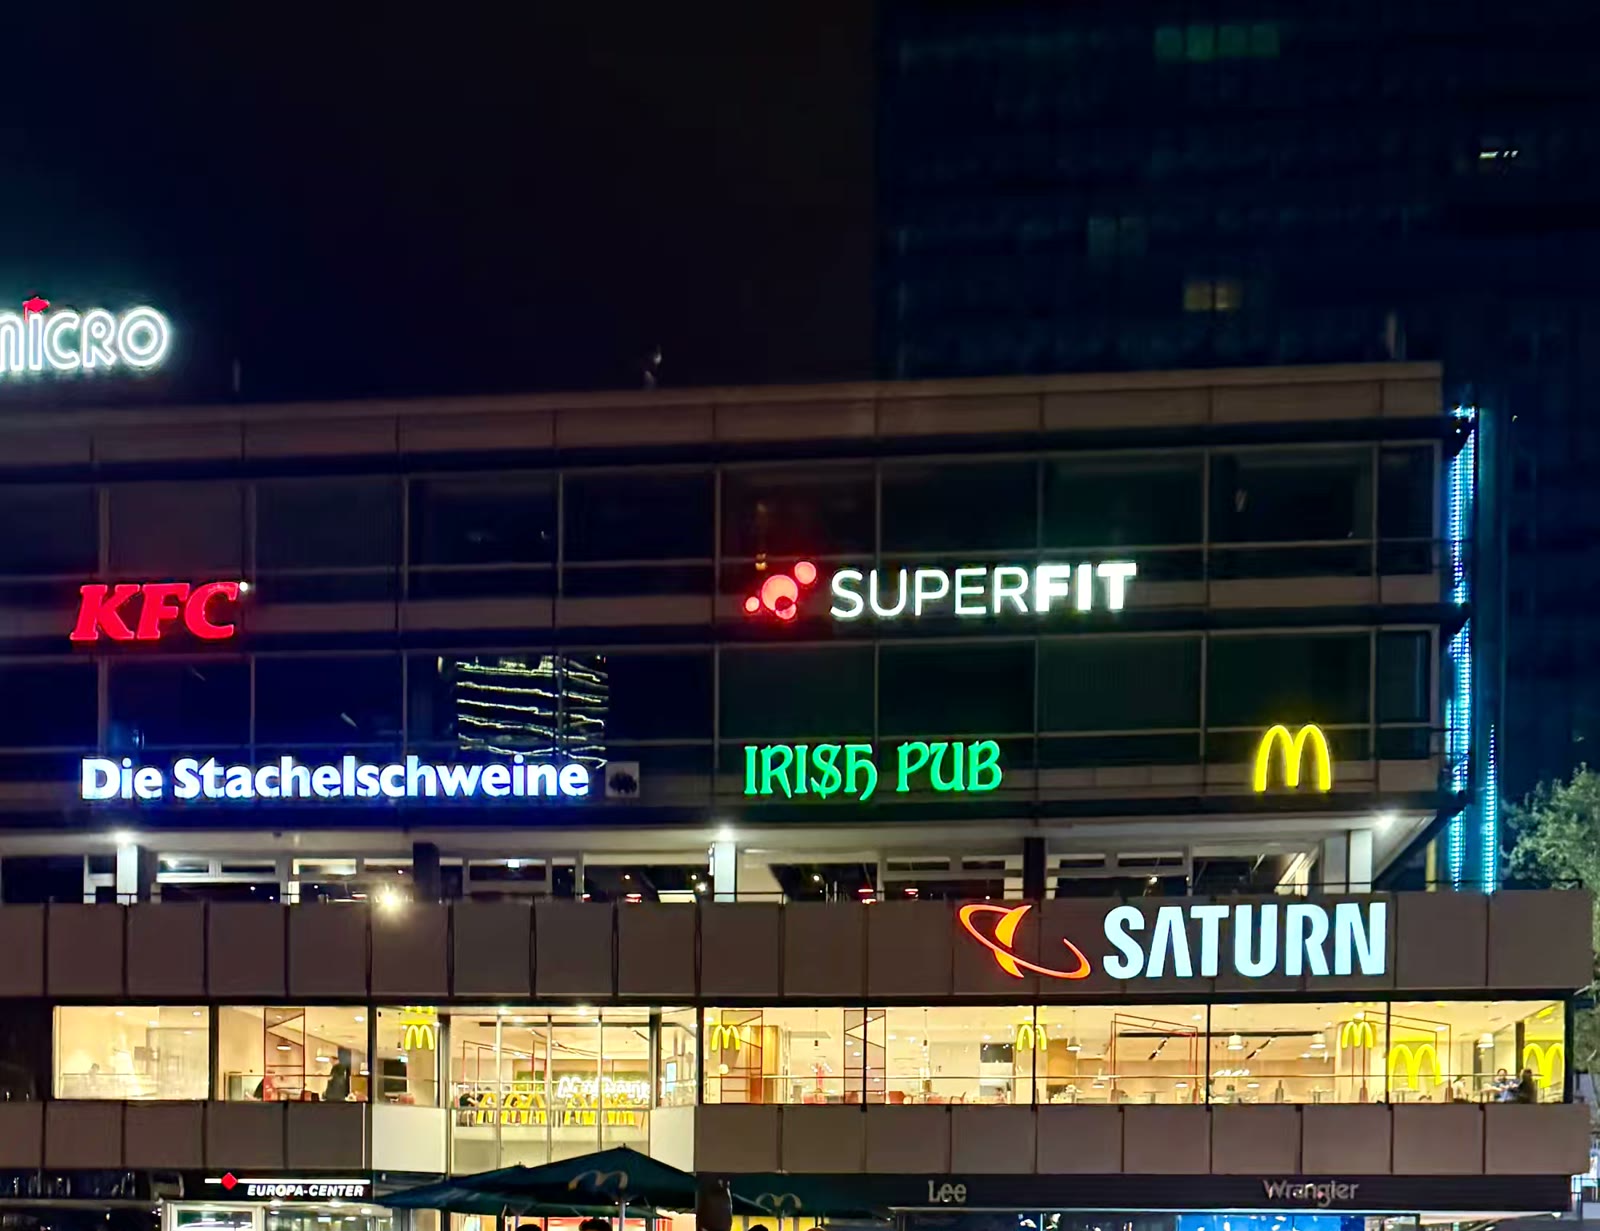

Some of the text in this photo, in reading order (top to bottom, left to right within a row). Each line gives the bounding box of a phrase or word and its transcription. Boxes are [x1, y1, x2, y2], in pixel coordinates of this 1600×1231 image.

[70, 582, 239, 640] KFC
[830, 562, 1137, 619] SUPERFIT
[82, 755, 590, 800] Die Stachelschweine
[744, 740, 1003, 801] IRISH PUB
[1103, 902, 1387, 980] SATURN
[247, 1184, 365, 1197] EUROPA-CENTER
[928, 1180, 967, 1203] Lee
[1263, 1180, 1359, 1208] Wrangler
